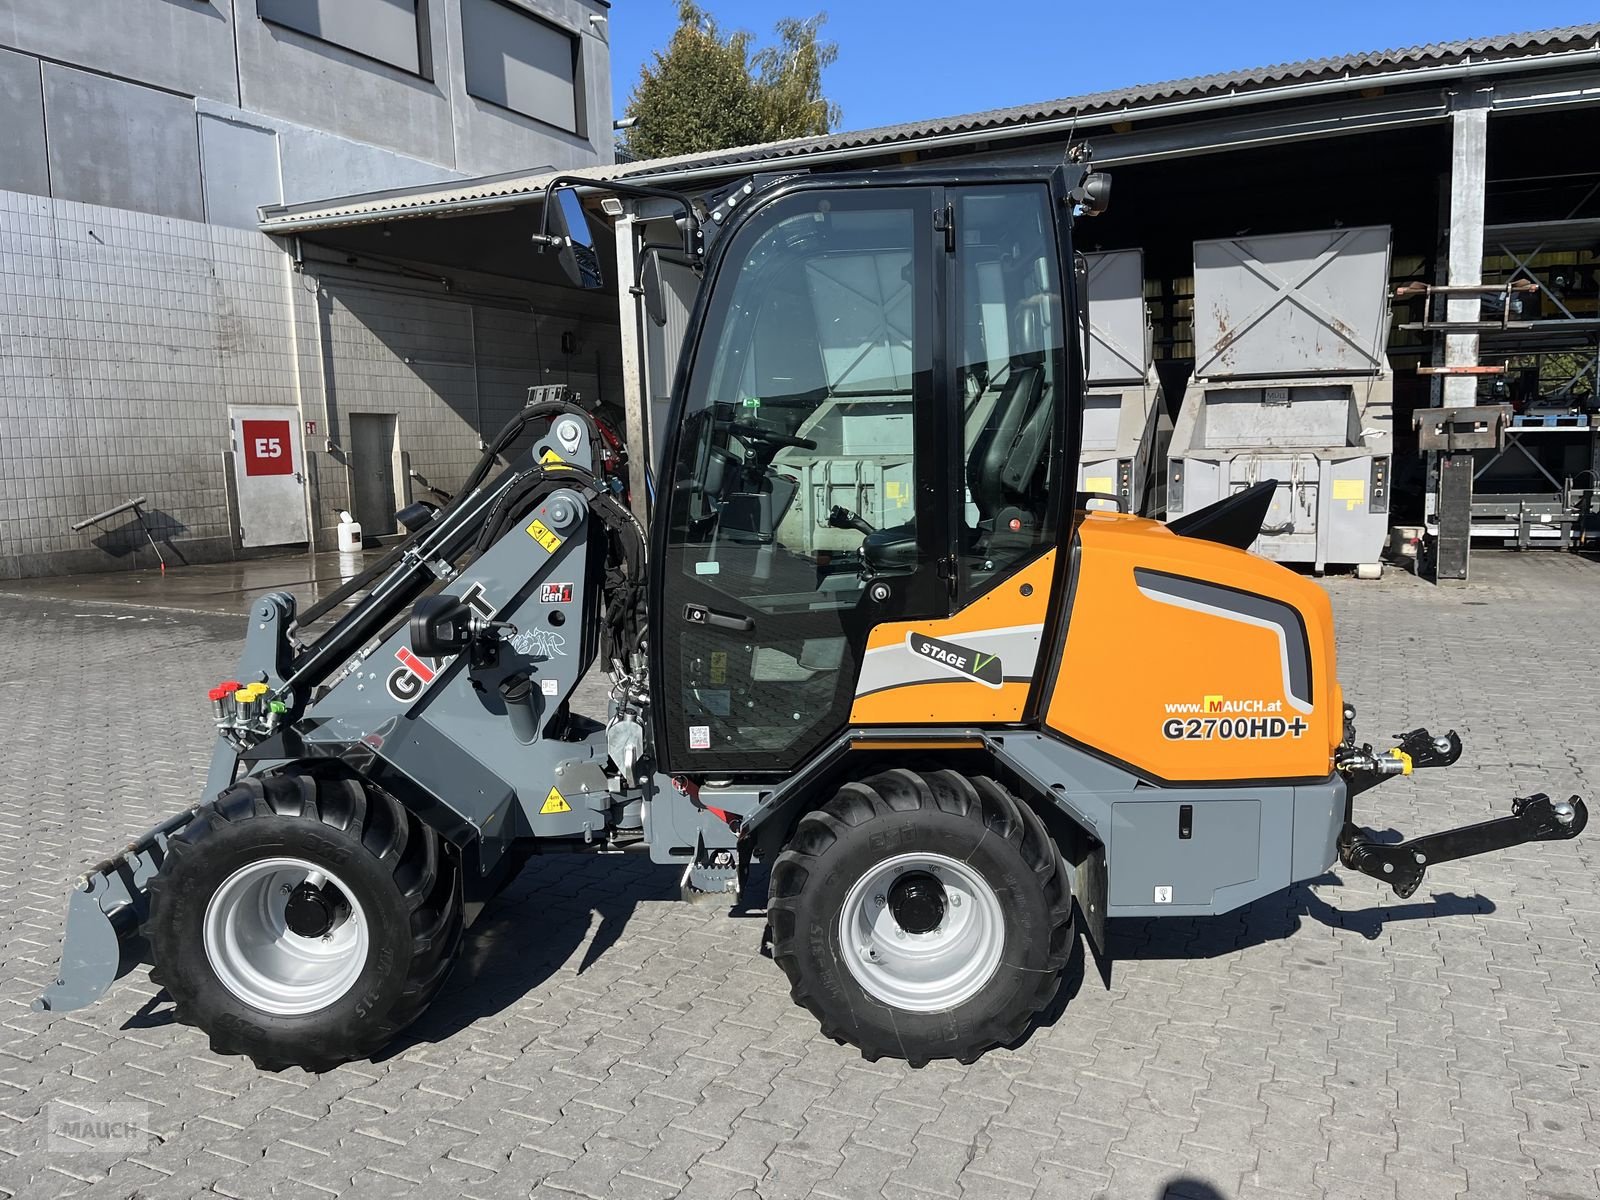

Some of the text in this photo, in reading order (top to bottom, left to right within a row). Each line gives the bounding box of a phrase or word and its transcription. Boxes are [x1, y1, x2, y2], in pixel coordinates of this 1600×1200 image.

[255, 438, 282, 458] E5
[920, 642, 998, 674] STAGE V
[1164, 699, 1283, 713] www.MAUCH.at
[1162, 716, 1308, 740] G2700HD+
